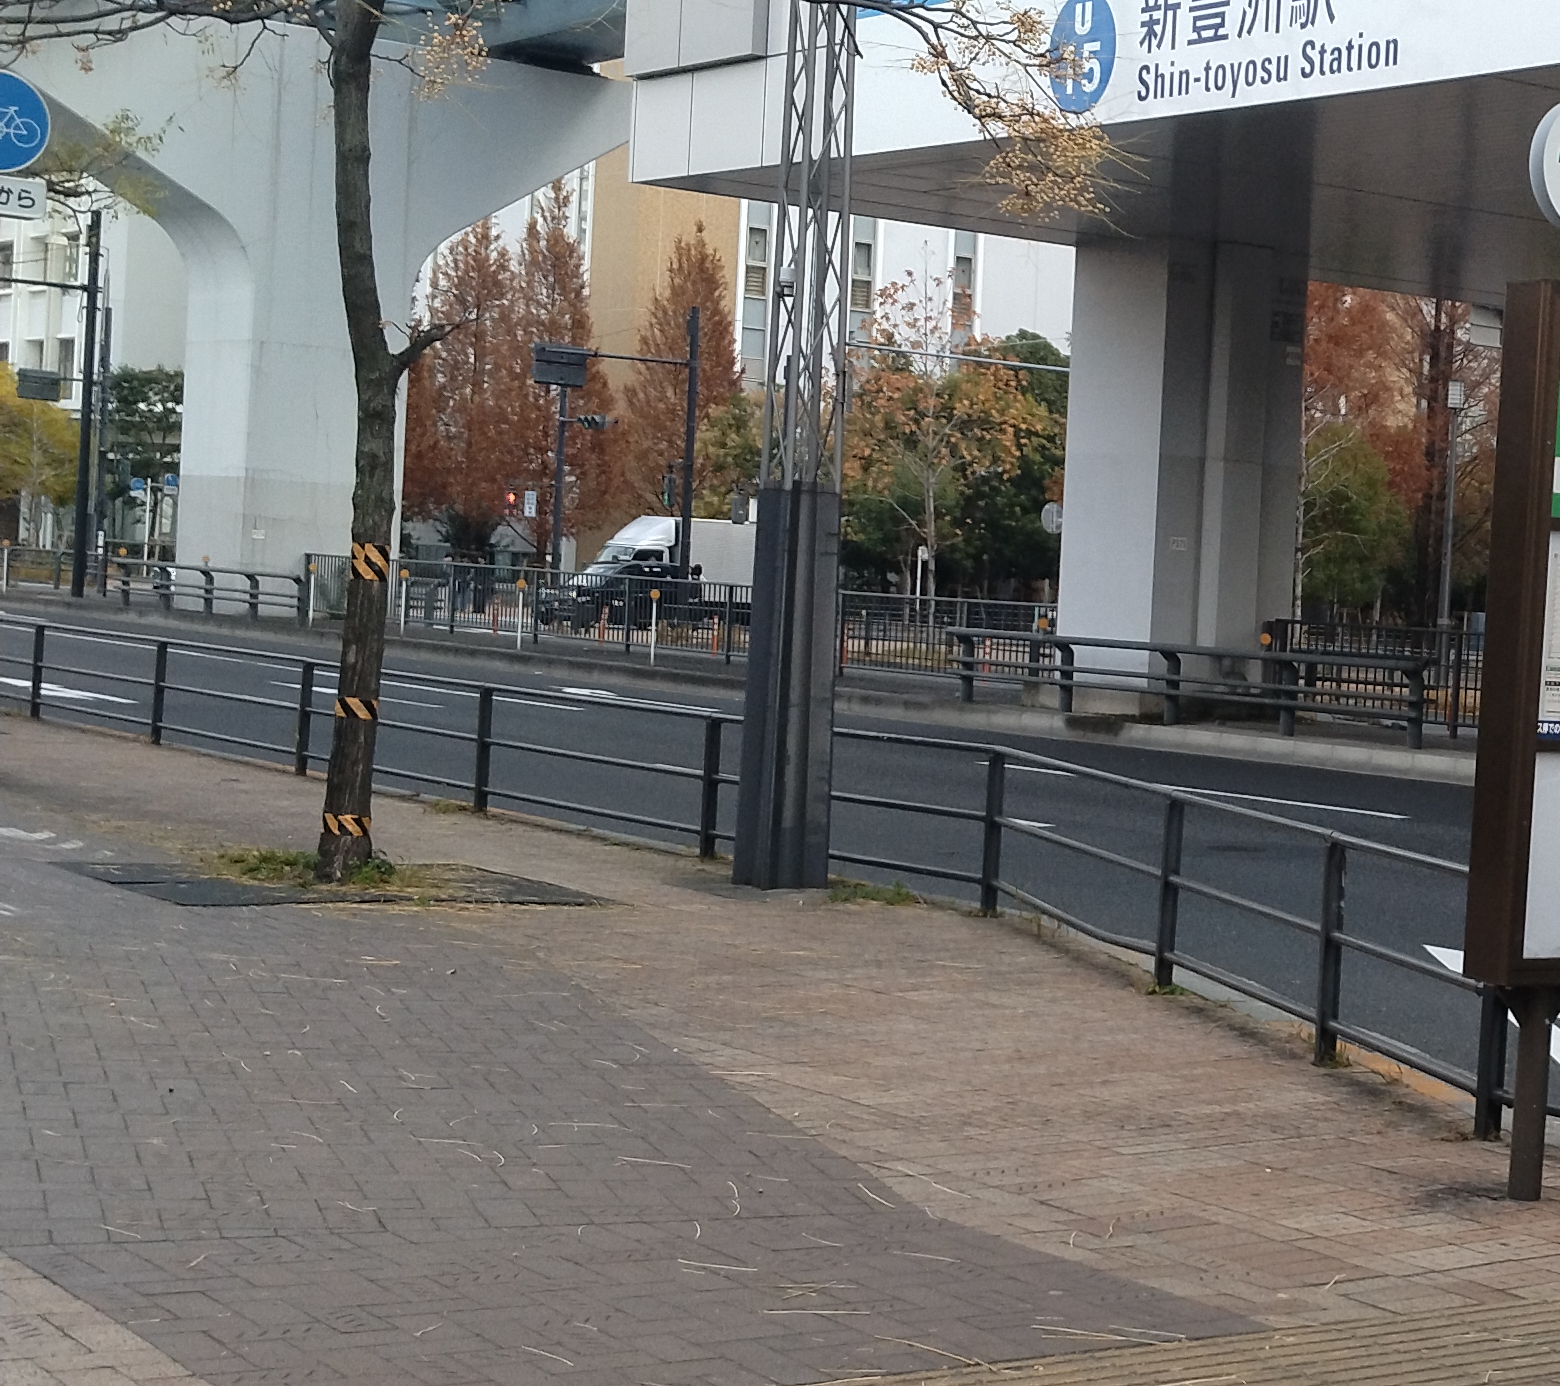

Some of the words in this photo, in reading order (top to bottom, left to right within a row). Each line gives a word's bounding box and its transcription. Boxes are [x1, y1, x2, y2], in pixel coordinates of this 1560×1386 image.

[1074, 0, 1093, 35] U
[1136, 51, 1289, 103] Shin-toyosu
[1301, 30, 1400, 79] Station
